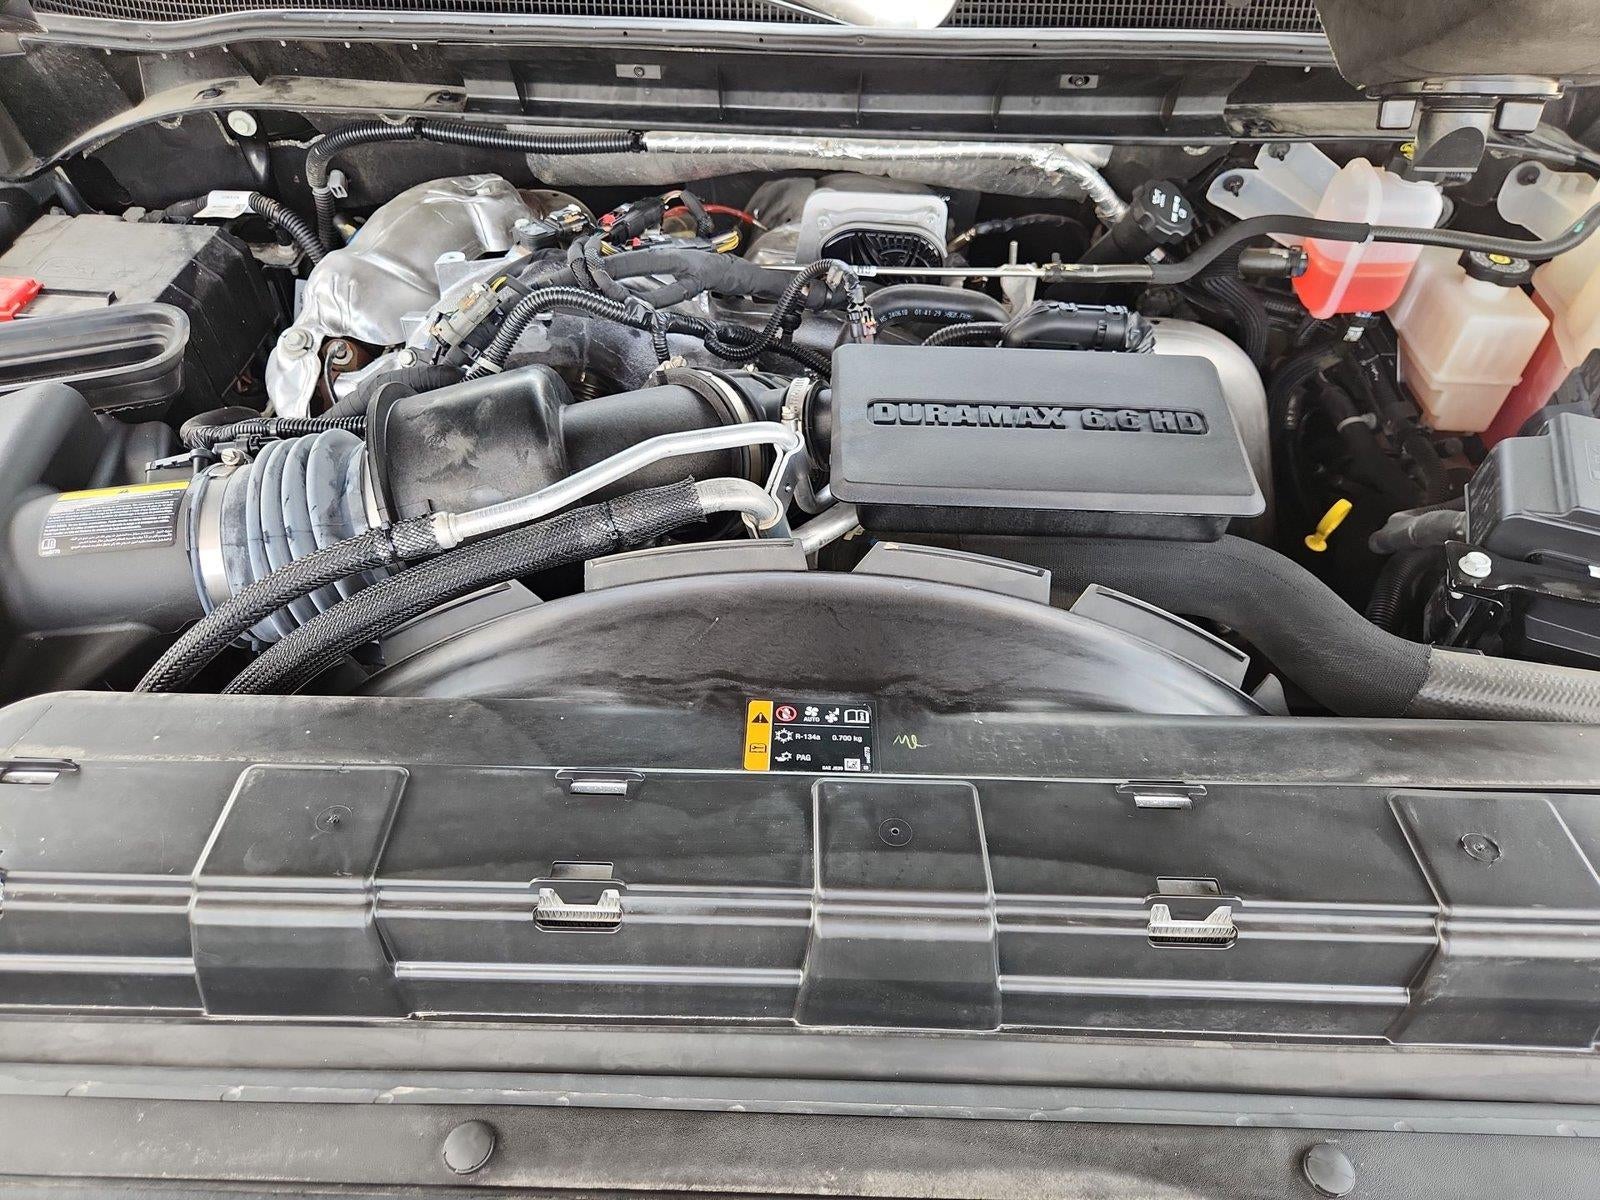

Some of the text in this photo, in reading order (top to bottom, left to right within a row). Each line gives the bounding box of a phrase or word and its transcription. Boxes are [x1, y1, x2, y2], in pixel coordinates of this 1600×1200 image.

[873, 402, 1205, 435] DURAMAX 6.6 HD
[795, 733, 863, 743] R-134a 0.700 kg
[796, 753, 812, 762] PAG
